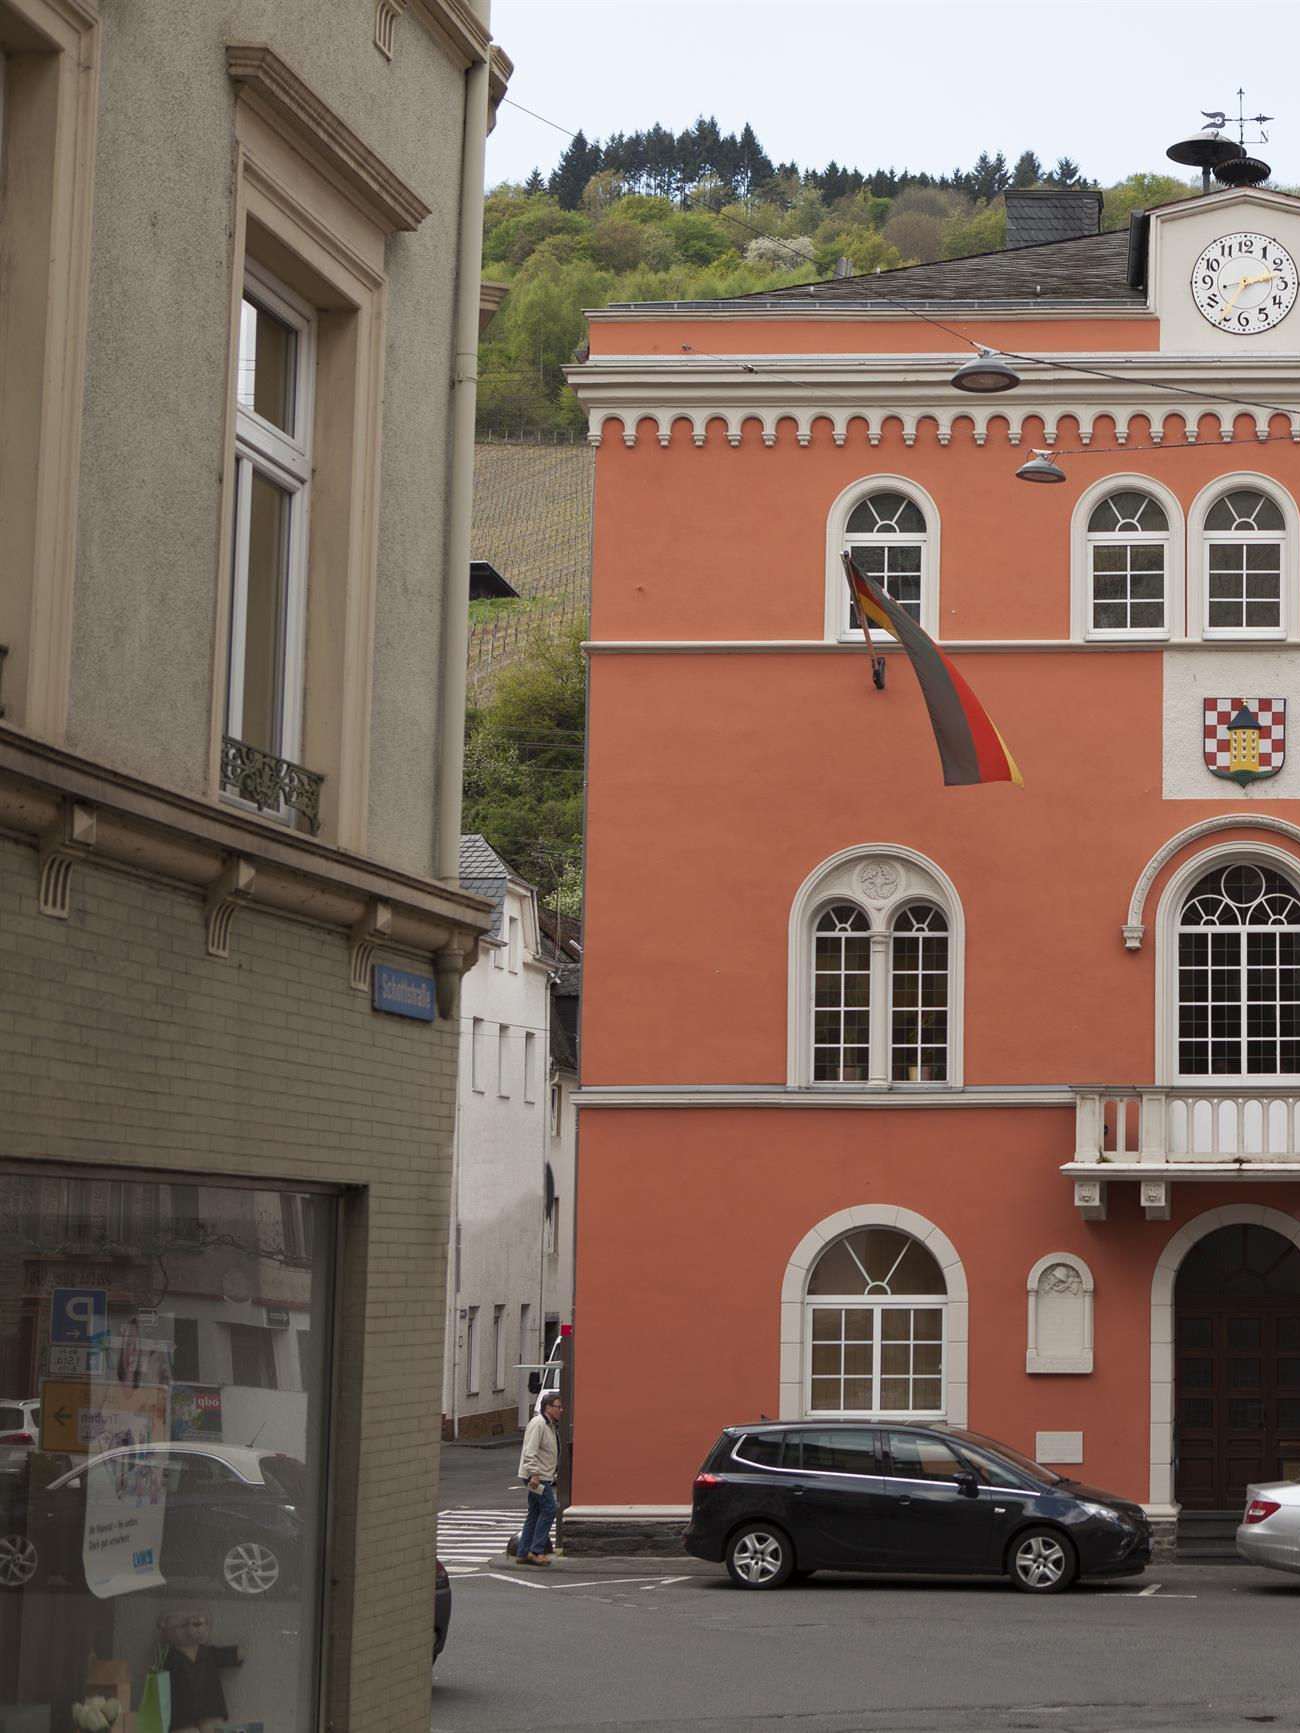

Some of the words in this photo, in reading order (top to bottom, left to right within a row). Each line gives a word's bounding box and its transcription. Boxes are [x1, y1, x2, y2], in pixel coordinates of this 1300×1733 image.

[1220, 243, 1233, 258] 11
[1238, 239, 1254, 255] 12
[1261, 245, 1268, 261] 1
[1205, 257, 1220, 272] 10
[1272, 257, 1284, 272] 2
[1200, 274, 1214, 291] 9
[1276, 275, 1289, 291] 3
[1271, 294, 1283, 309] 4
[1237, 310, 1251, 327] 6
[1256, 307, 1269, 322] 5
